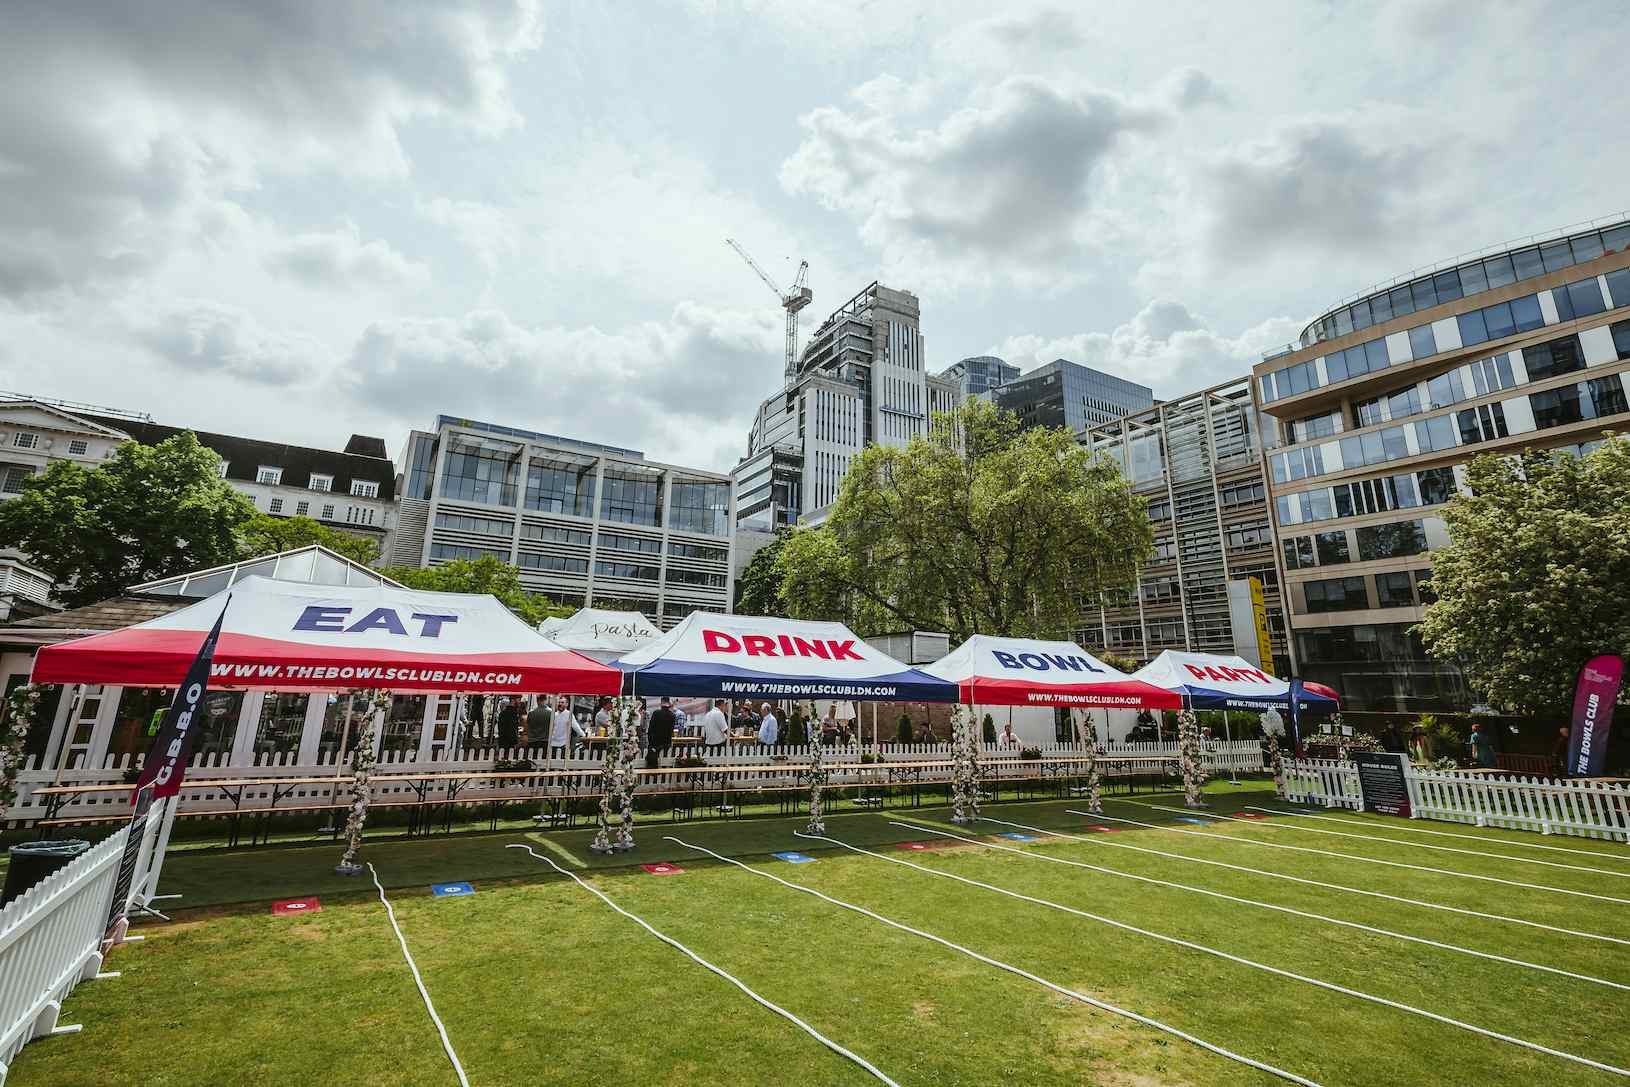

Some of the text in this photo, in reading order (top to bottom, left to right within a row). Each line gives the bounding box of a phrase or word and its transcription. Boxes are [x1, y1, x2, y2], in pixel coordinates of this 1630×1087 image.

[292, 606, 458, 638] EAT
[702, 630, 865, 661] DRINK
[992, 650, 1106, 673] BOWL
[210, 663, 522, 685] WWW.THEBOWLSCLUBLDN.COM
[1183, 664, 1271, 684] PARTY
[721, 682, 896, 696] WWW.THEBOWLSCLUBLDN.COM
[1027, 693, 1142, 705] WWW.THEBOWLSCLUBLDN.COM
[1586, 693, 1600, 719] CLUB
[1581, 719, 1594, 756] BOWLS
[1577, 754, 1589, 774] THE
